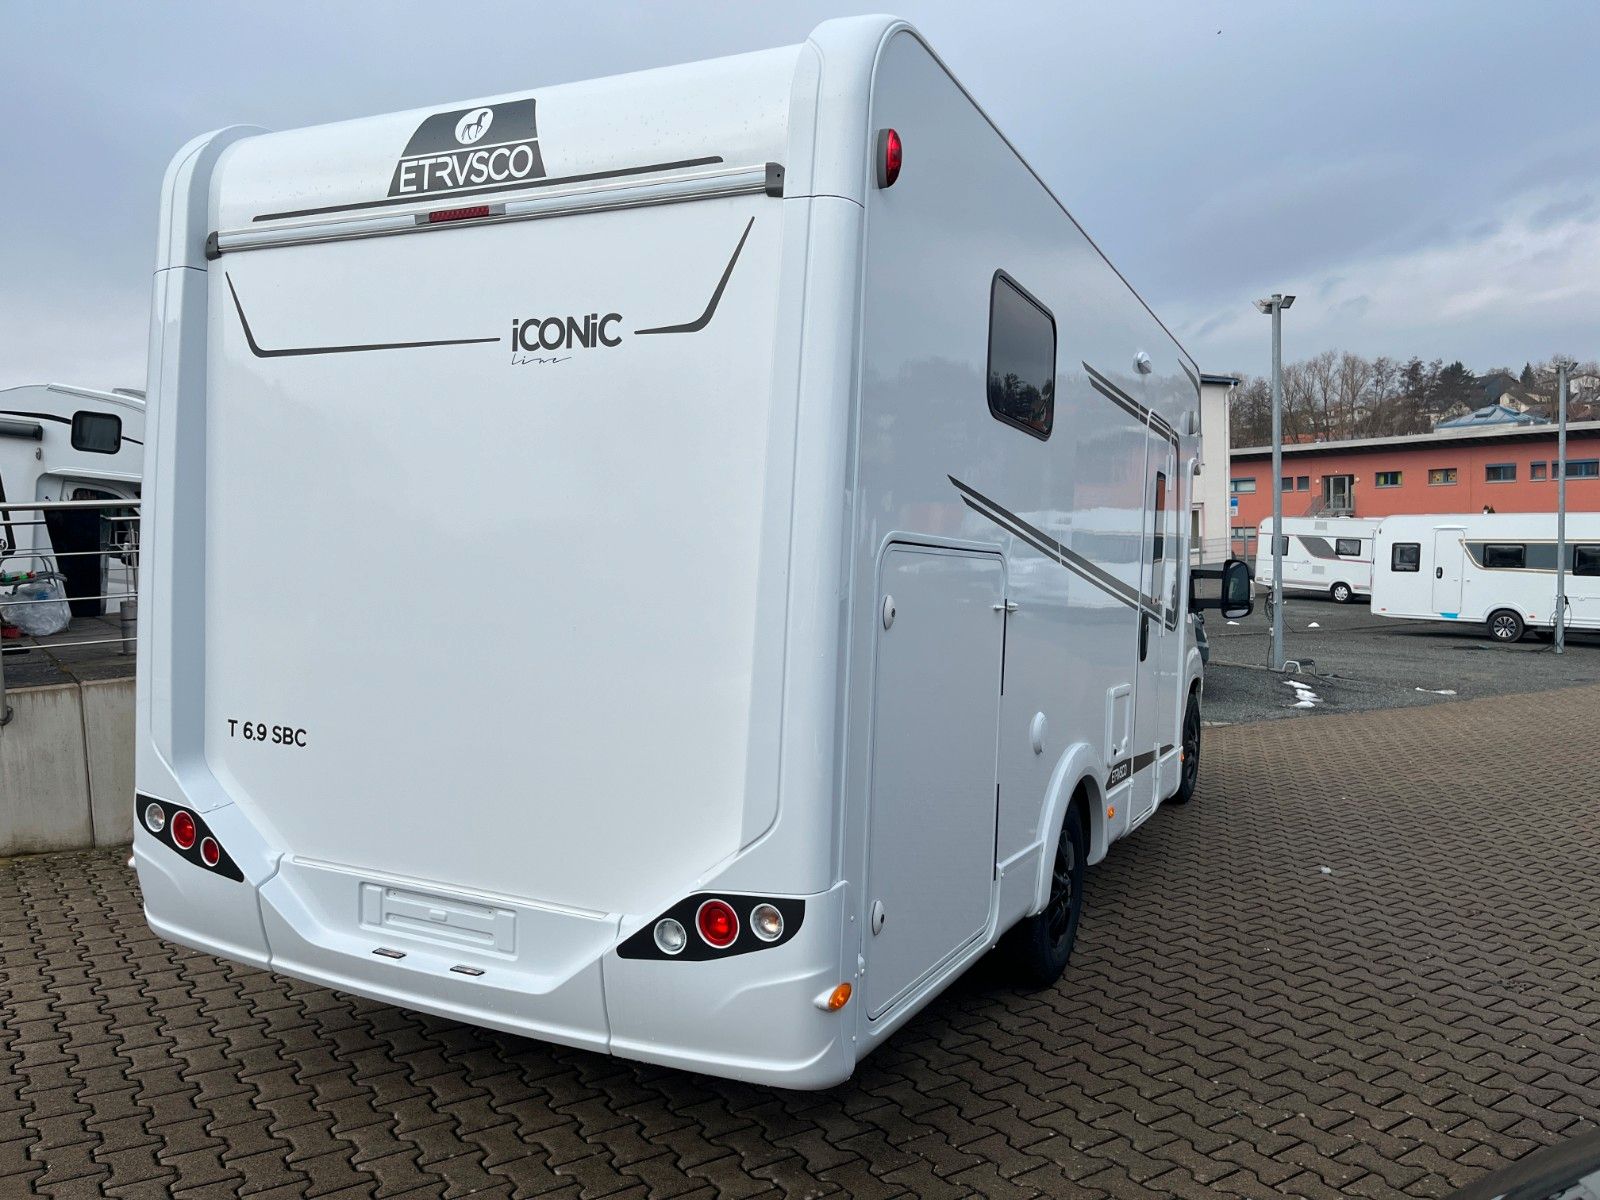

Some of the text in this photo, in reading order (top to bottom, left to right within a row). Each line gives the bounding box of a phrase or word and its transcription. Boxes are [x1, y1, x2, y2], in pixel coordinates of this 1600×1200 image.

[511, 353, 572, 365] line
[227, 719, 307, 747] T 6.9 SBC
